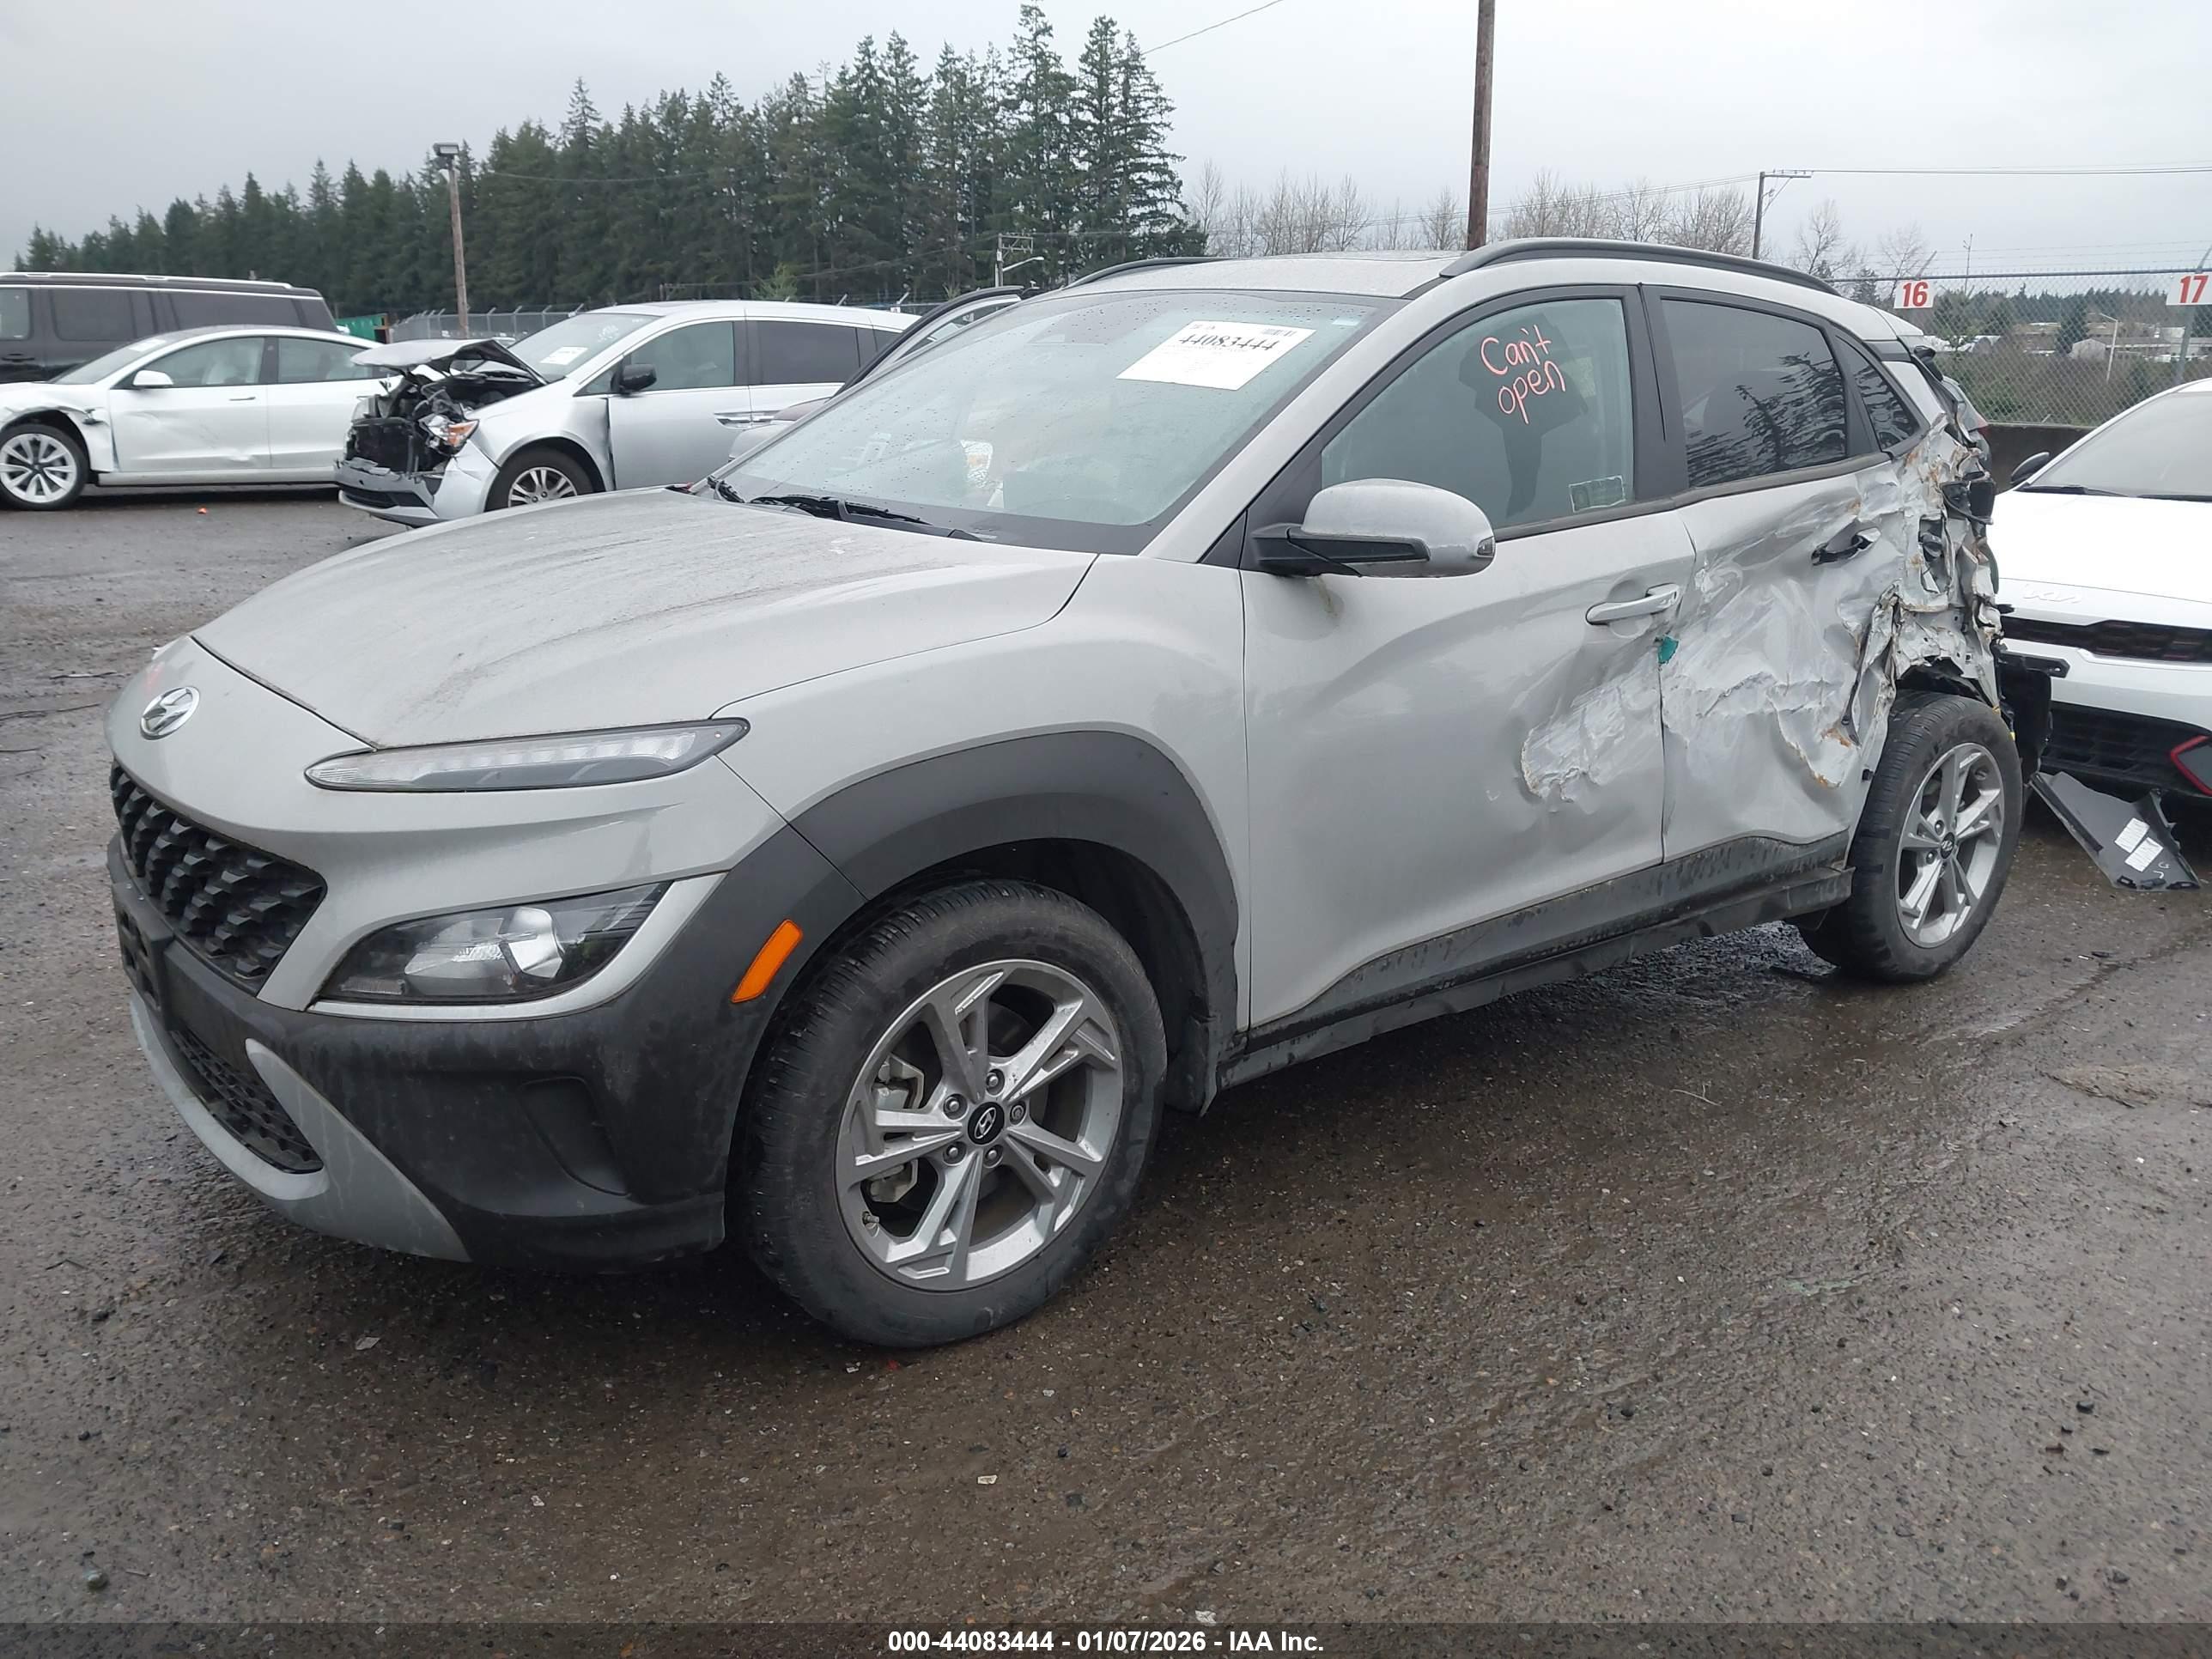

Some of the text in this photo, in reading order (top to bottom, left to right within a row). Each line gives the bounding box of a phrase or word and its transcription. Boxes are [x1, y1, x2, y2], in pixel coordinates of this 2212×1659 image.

[1902, 281, 1929, 307] 16
[2179, 275, 2209, 304] 17
[1178, 332, 1280, 351] 44083444
[1480, 324, 1553, 375] Can't
[1498, 360, 1566, 425] open
